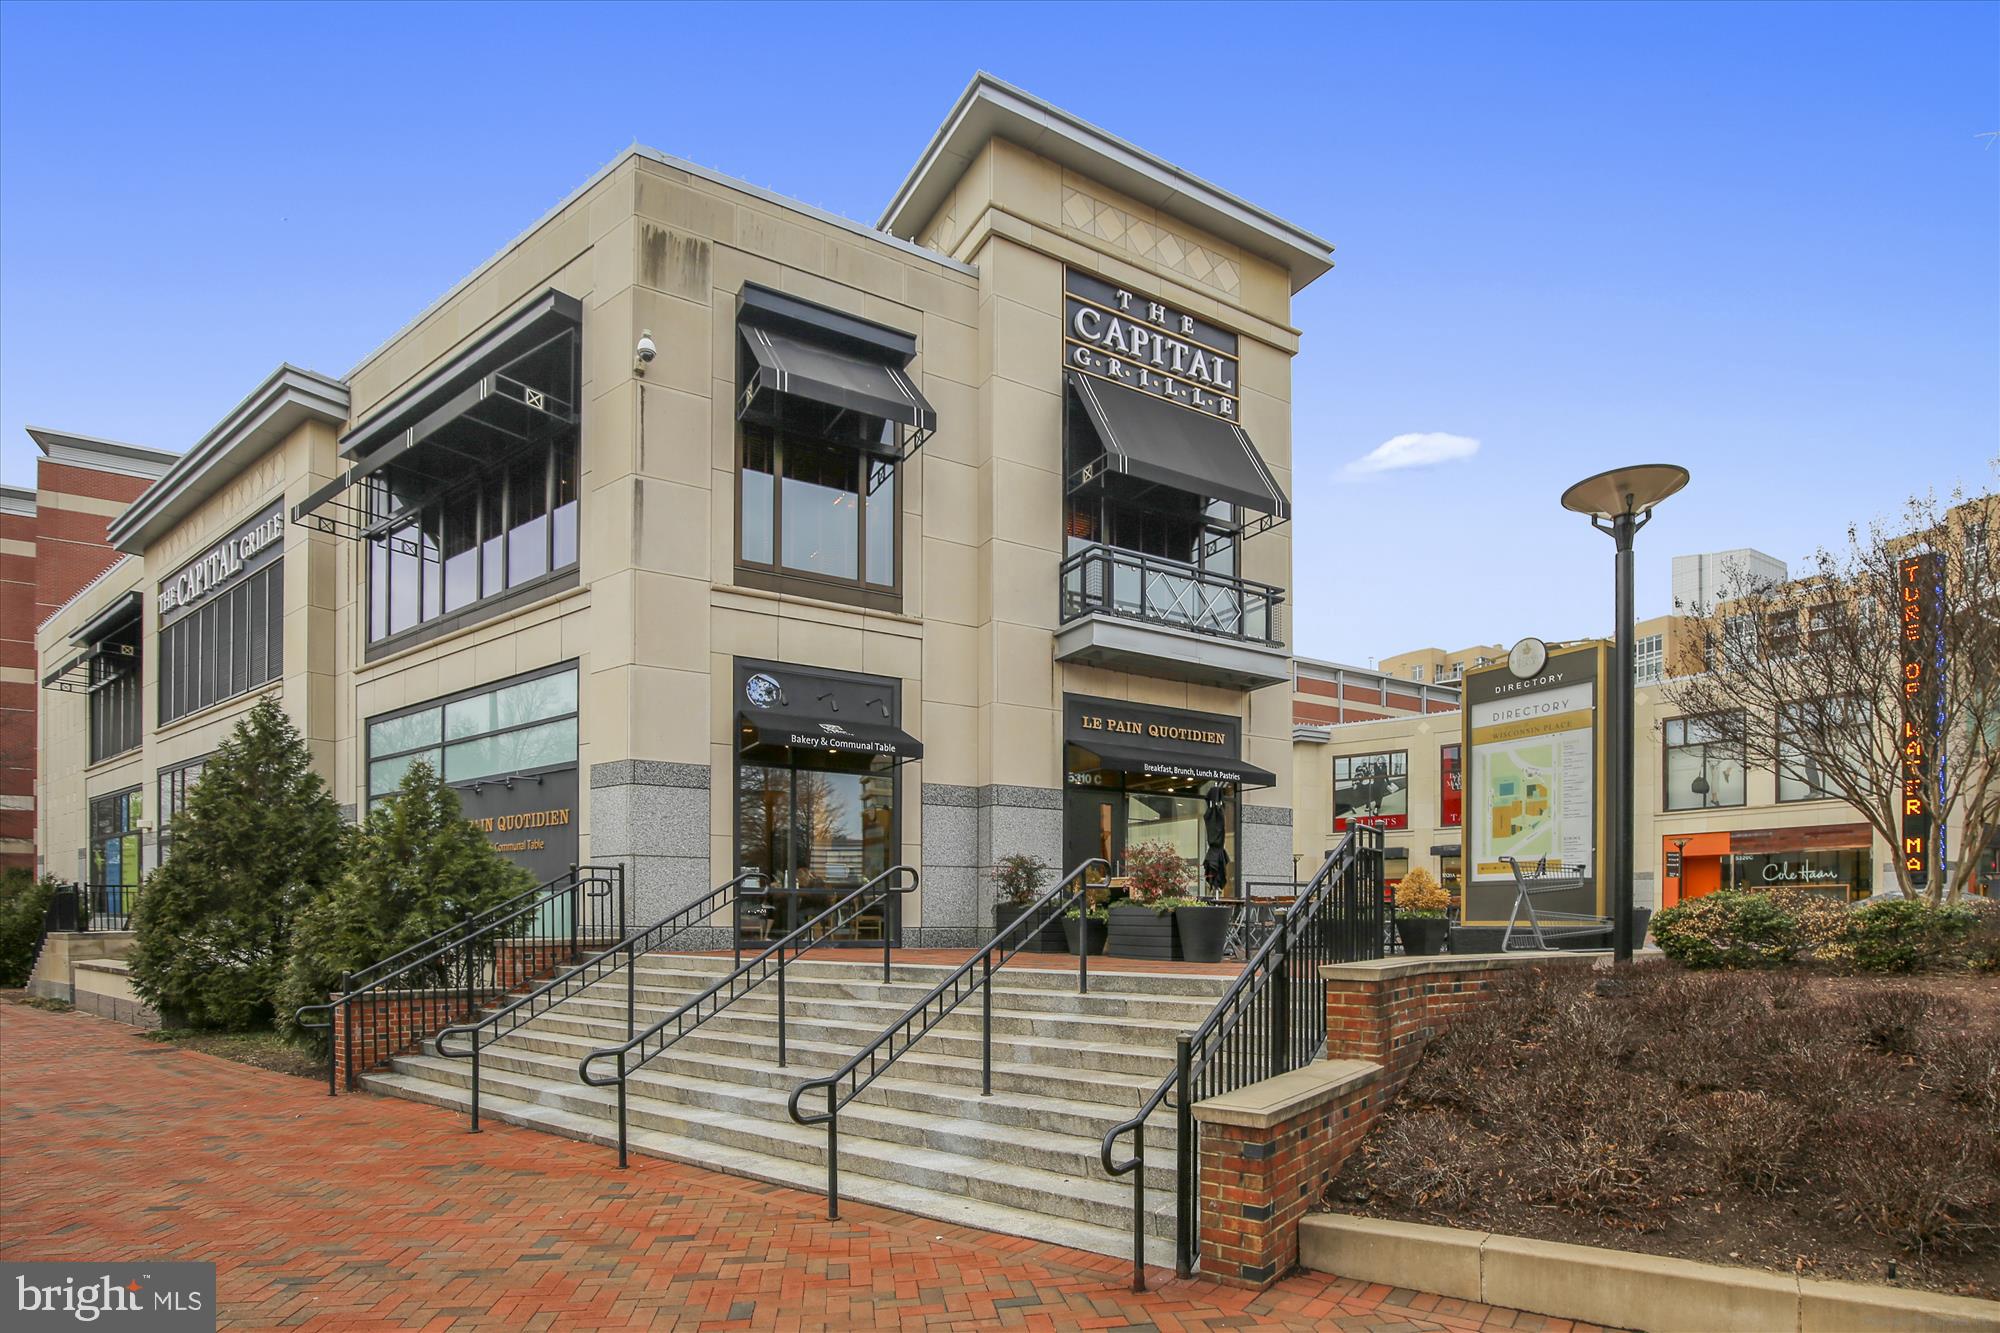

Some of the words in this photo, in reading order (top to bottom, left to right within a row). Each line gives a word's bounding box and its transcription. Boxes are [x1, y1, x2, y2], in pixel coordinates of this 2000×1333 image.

[1117, 289, 1194, 336] THE
[1074, 307, 1232, 390] CAPITAL
[159, 586, 178, 614] THE
[177, 539, 243, 607] CAPITAL
[240, 511, 284, 560] GRILLE
[1495, 673, 1564, 694] DIRECTORY
[1492, 699, 1570, 722] DIRECTORY
[1082, 715, 1102, 730] LE
[1107, 719, 1142, 735] PAIN
[1148, 724, 1226, 745] QUOTIDIEN
[1493, 724, 1541, 740] WISCONSIN
[1543, 720, 1573, 733] PLACE
[791, 734, 819, 748] Bakery
[820, 736, 828, 746] &
[829, 738, 873, 751] Communal
[874, 742, 896, 753] Table
[1068, 771, 1092, 784] 5310
[1144, 763, 1174, 775] Breakfast,
[1174, 766, 1196, 777] Brunch,
[1196, 769, 1213, 779] Lunch
[1213, 770, 1219, 778] &
[1219, 771, 1241, 781] Pastries
[497, 808, 569, 832] QUOTIDIEN
[495, 840, 527, 853] Communal
[527, 838, 545, 850] Table
[1762, 861, 1797, 881] Cole
[1797, 859, 1838, 883] Haan
